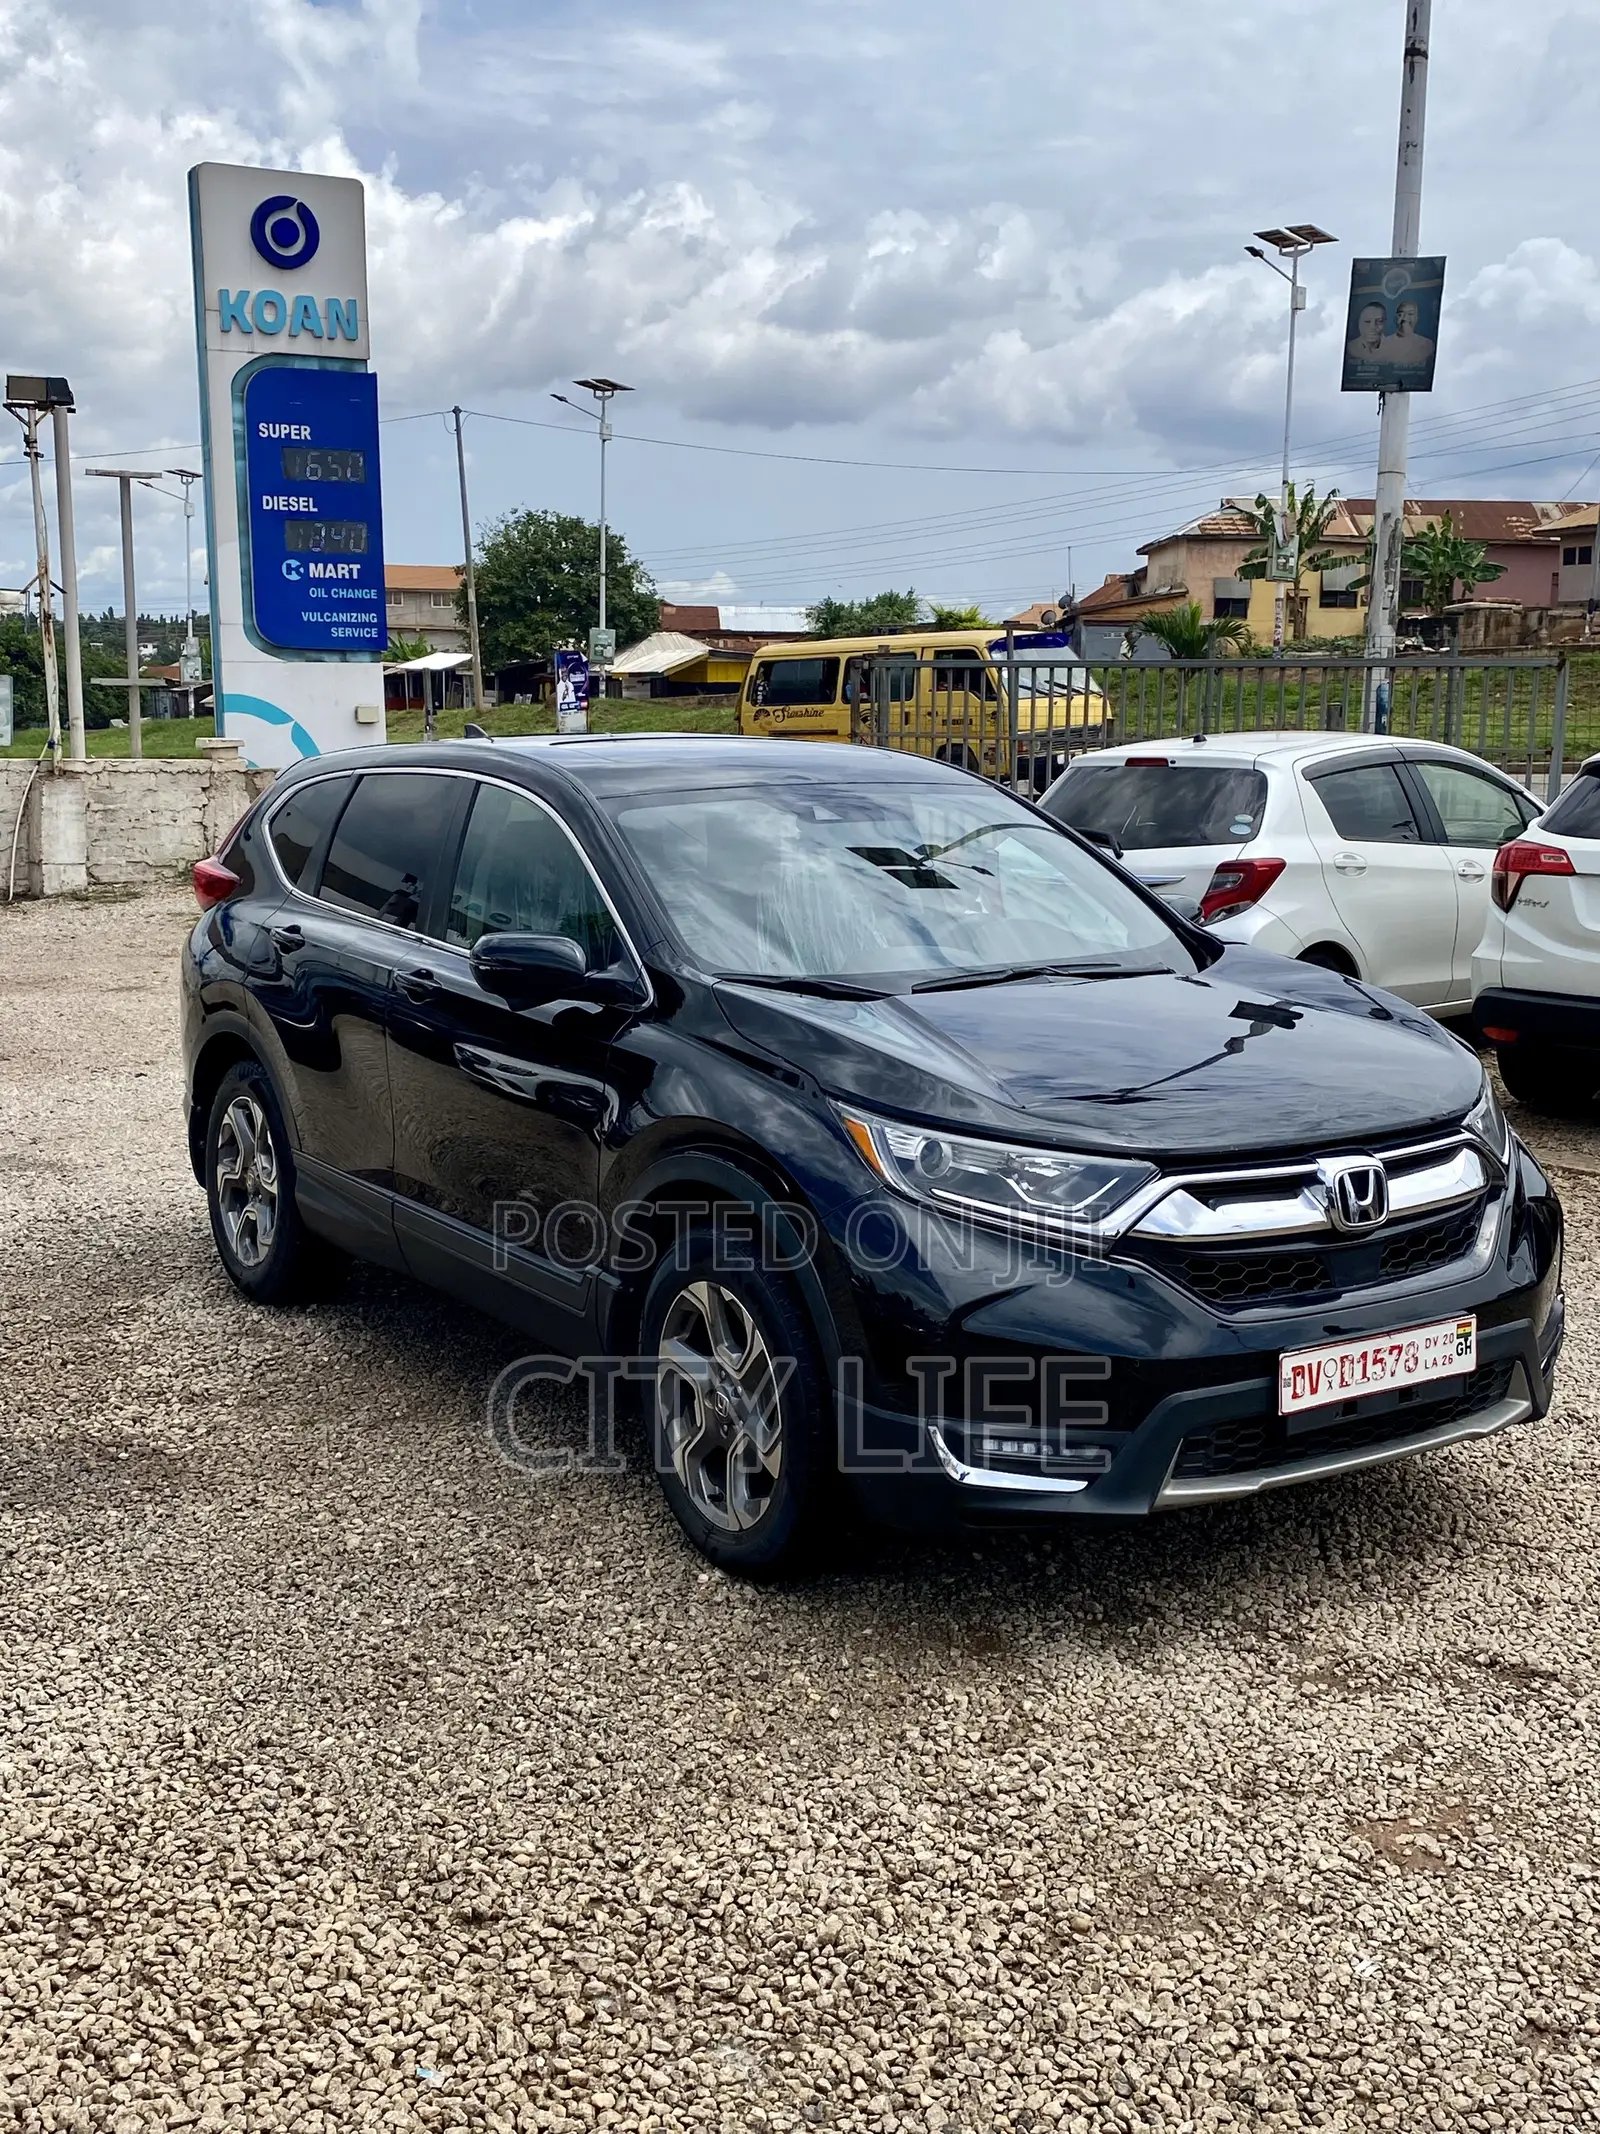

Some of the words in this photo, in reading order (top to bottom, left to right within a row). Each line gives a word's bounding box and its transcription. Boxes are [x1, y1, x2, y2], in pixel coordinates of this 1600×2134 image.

[218, 289, 358, 341] KOAN
[258, 422, 312, 441] SUPER
[262, 495, 318, 512] DIESEL
[309, 562, 361, 579] MART
[309, 587, 328, 598] OIL
[331, 588, 378, 599] CHANGE
[301, 611, 378, 623] VULCANIZING
[331, 627, 378, 638] SERVICE
[772, 706, 825, 723] Sunshine
[1425, 1335, 1439, 1349] DV
[1442, 1332, 1455, 1346] 20
[1455, 1337, 1472, 1357] GH
[1291, 1360, 1322, 1400] DV
[1339, 1340, 1419, 1389] D1578
[1424, 1357, 1438, 1370] LA
[1441, 1353, 1454, 1366] 26
